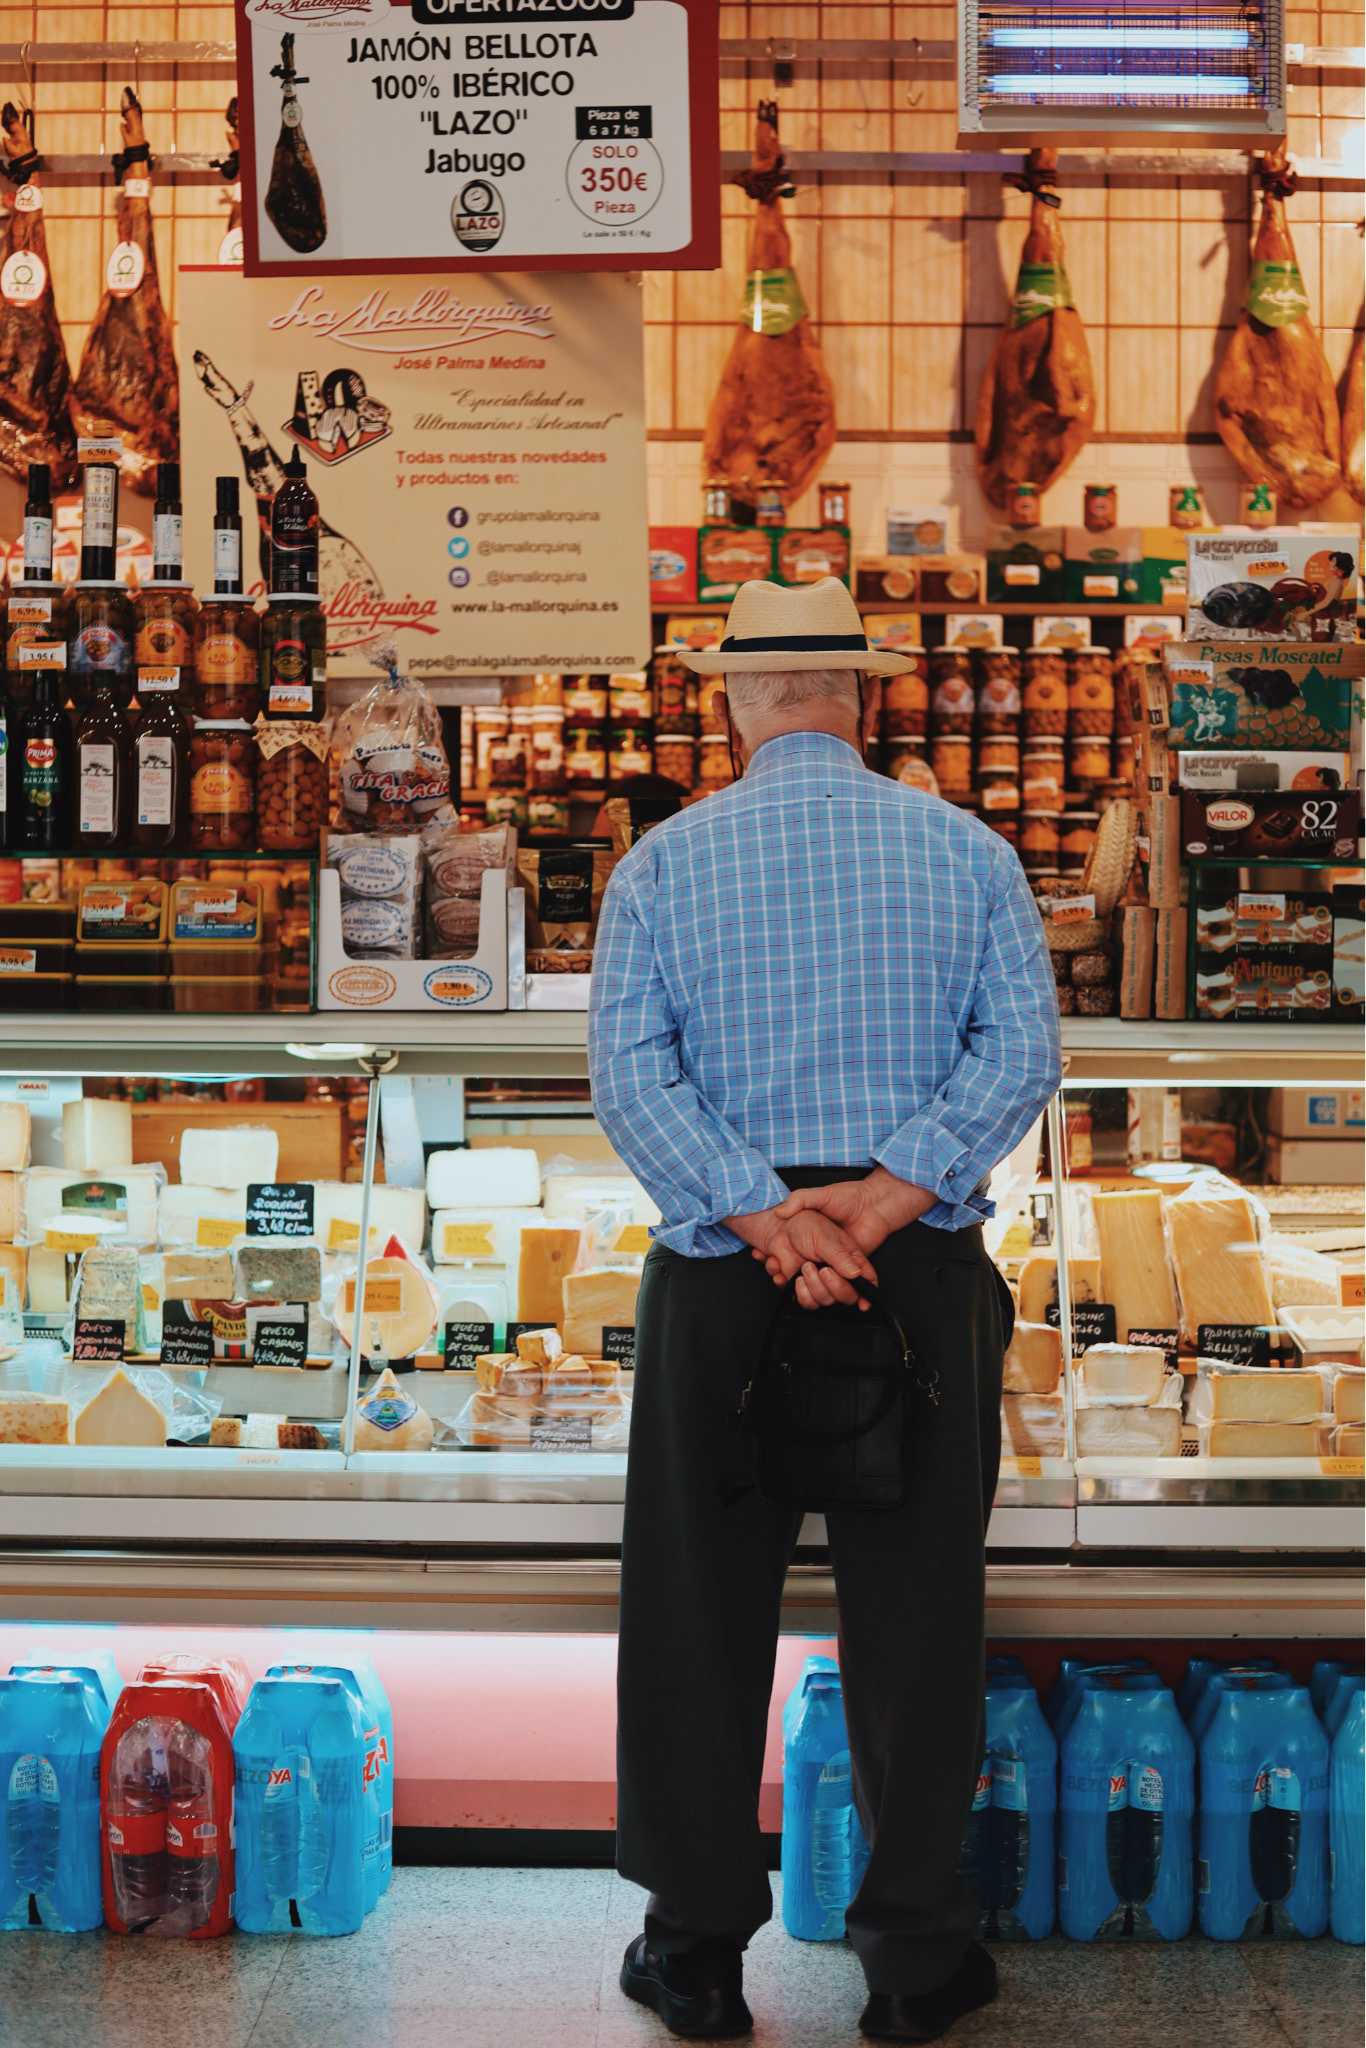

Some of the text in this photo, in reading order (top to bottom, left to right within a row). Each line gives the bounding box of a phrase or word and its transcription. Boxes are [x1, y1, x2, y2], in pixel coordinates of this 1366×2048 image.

[322, 20, 342, 28] Palma
[347, 32, 598, 63] JAMÓN BELLOTA
[371, 67, 574, 100] 100% IBÉRICO
[588, 109, 640, 120] Pieza de
[421, 108, 527, 135] "LAZO"
[589, 124, 639, 137] 6 a 7 kg
[592, 145, 638, 159] SOLO
[424, 148, 525, 177] Jabugo
[581, 166, 648, 193] 350€
[594, 200, 636, 214] Pieza
[456, 217, 500, 232] LAZO
[8, 284, 36, 293] LAZO
[268, 285, 554, 338] La Mallorquina
[393, 356, 546, 370] José Palma Medina
[87, 448, 107, 456] 6,50
[396, 449, 607, 464] Todas nuestras novedades
[396, 472, 519, 487] y productos en:
[1255, 562, 1279, 570] 15,00
[17, 607, 38, 616] 6,95
[451, 598, 619, 615] www.la-mallorquina.es
[29, 652, 47, 661] 3,95
[1200, 646, 1343, 664] Pasas Moscatel
[408, 654, 635, 671] pepe@malagalamallorquina.com
[28, 748, 54, 758] PRIMA
[1208, 810, 1248, 821] VALOR
[1301, 800, 1337, 830] 82
[1302, 830, 1336, 838] CACAO
[347, 865, 395, 876] ALMENDRAS
[91, 903, 110, 912] 3,95
[343, 918, 392, 926] ALMENDRAS
[1233, 958, 1304, 983] Antiguo
[442, 982, 461, 990] 3,80
[79, 1320, 113, 1334] QUESO
[260, 1326, 295, 1337] QUESO
[451, 1323, 486, 1333] QUESO
[608, 1332, 635, 1343] QUES
[1203, 1327, 1266, 1341] PARMESANO
[259, 1338, 304, 1351] CABRALES
[461, 1344, 490, 1353] CABRA
